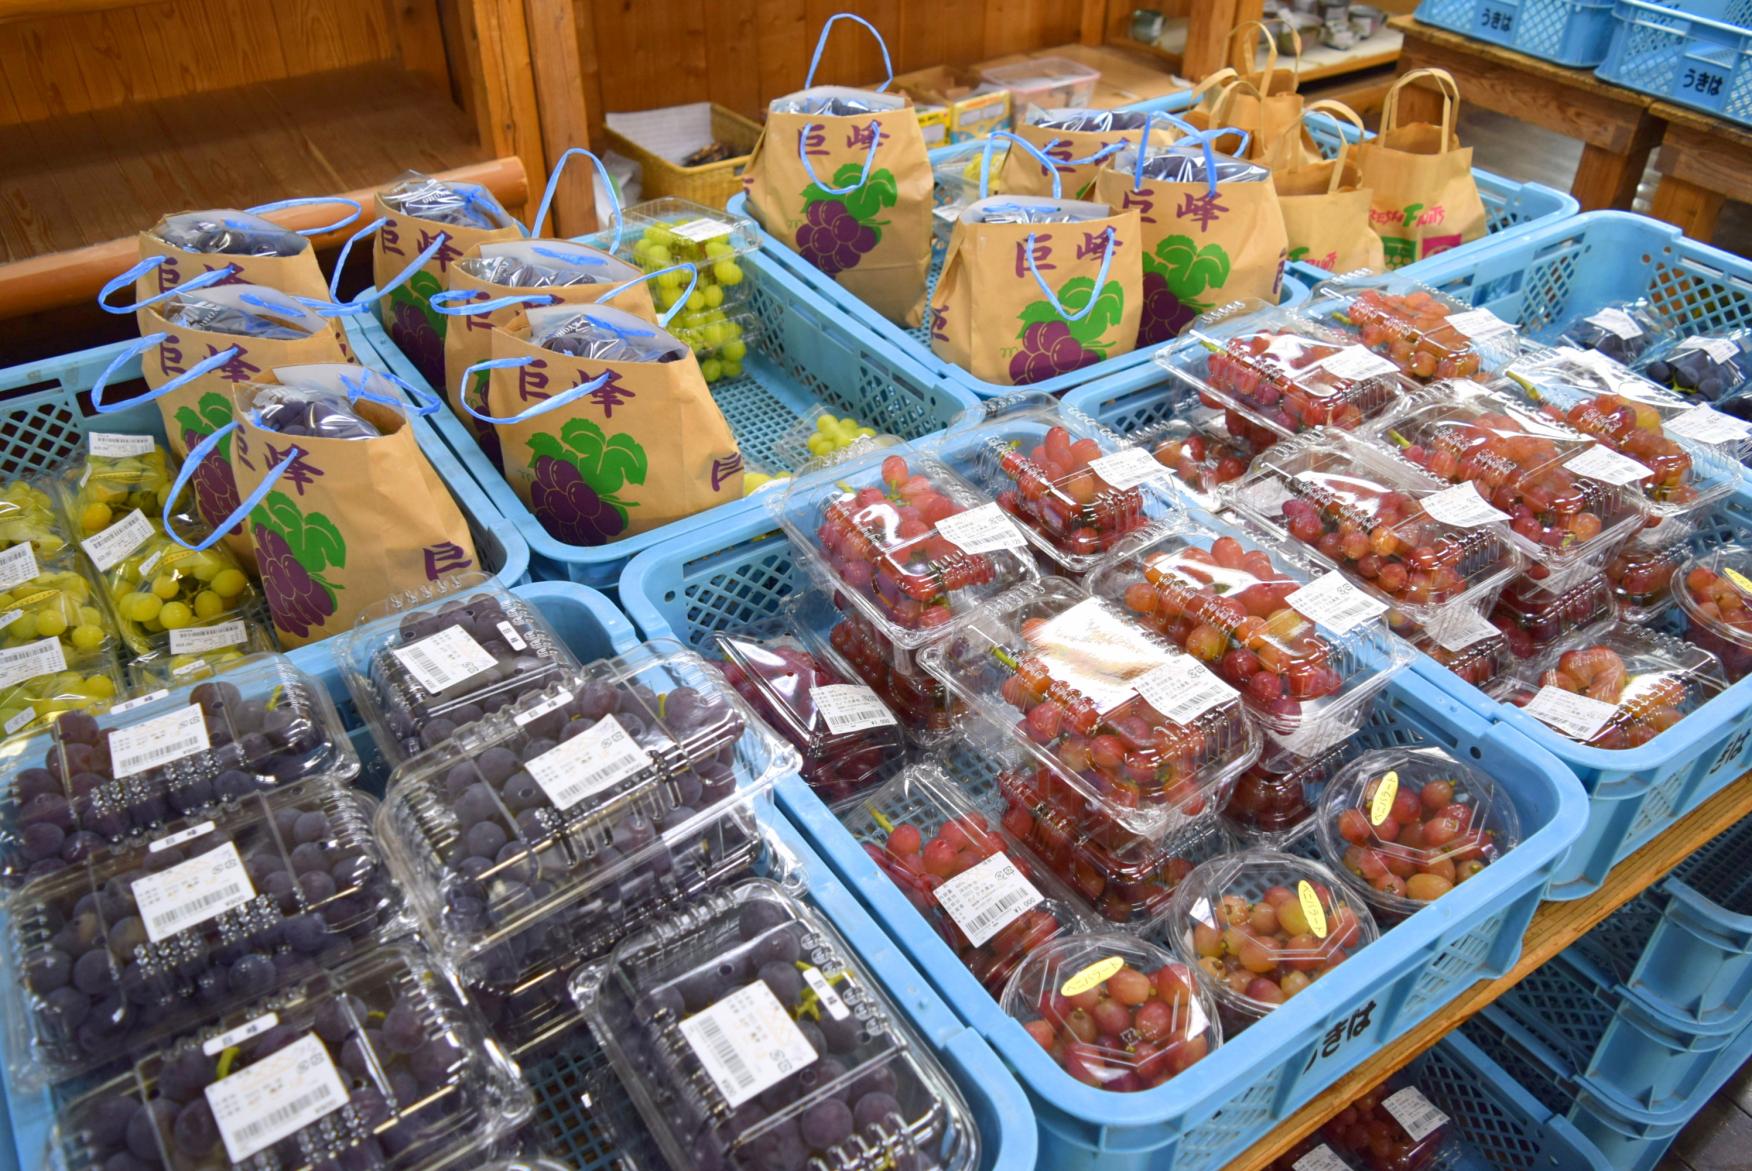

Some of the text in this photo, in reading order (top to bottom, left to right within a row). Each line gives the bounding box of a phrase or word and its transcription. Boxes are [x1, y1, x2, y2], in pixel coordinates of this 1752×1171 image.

[1480, 8, 1514, 32] うきは
[1683, 69, 1724, 96] うきは
[380, 219, 464, 272] 巨峰
[518, 358, 636, 419] 巨峰
